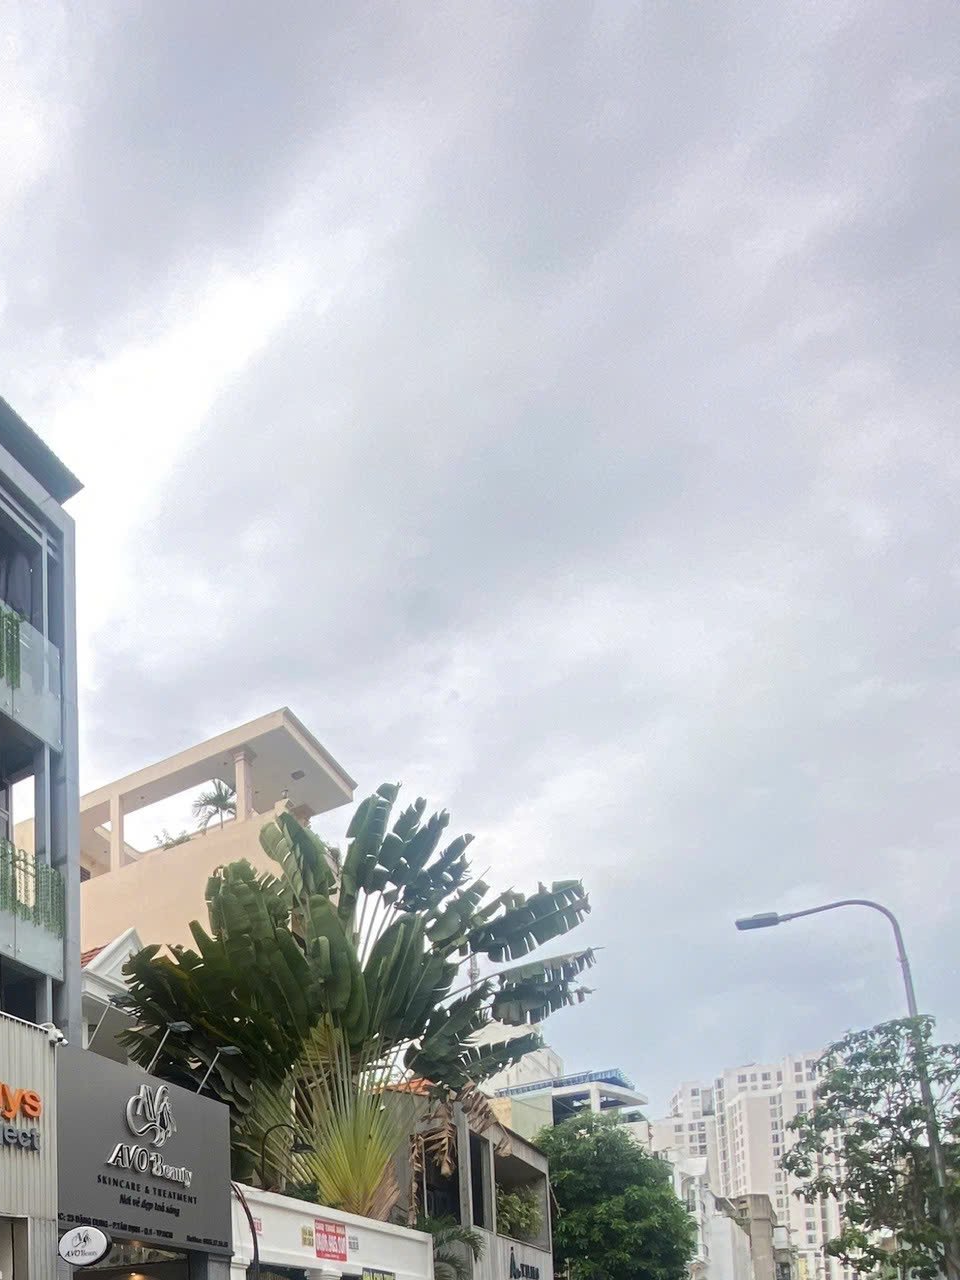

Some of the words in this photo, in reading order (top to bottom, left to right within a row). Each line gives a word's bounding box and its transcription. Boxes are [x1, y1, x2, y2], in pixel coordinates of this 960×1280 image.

[107, 1143, 150, 1173] AVO
[97, 1174, 141, 1193] SKINCARE
[144, 1185, 150, 1195] &
[153, 1187, 198, 1205] TREATMENT
